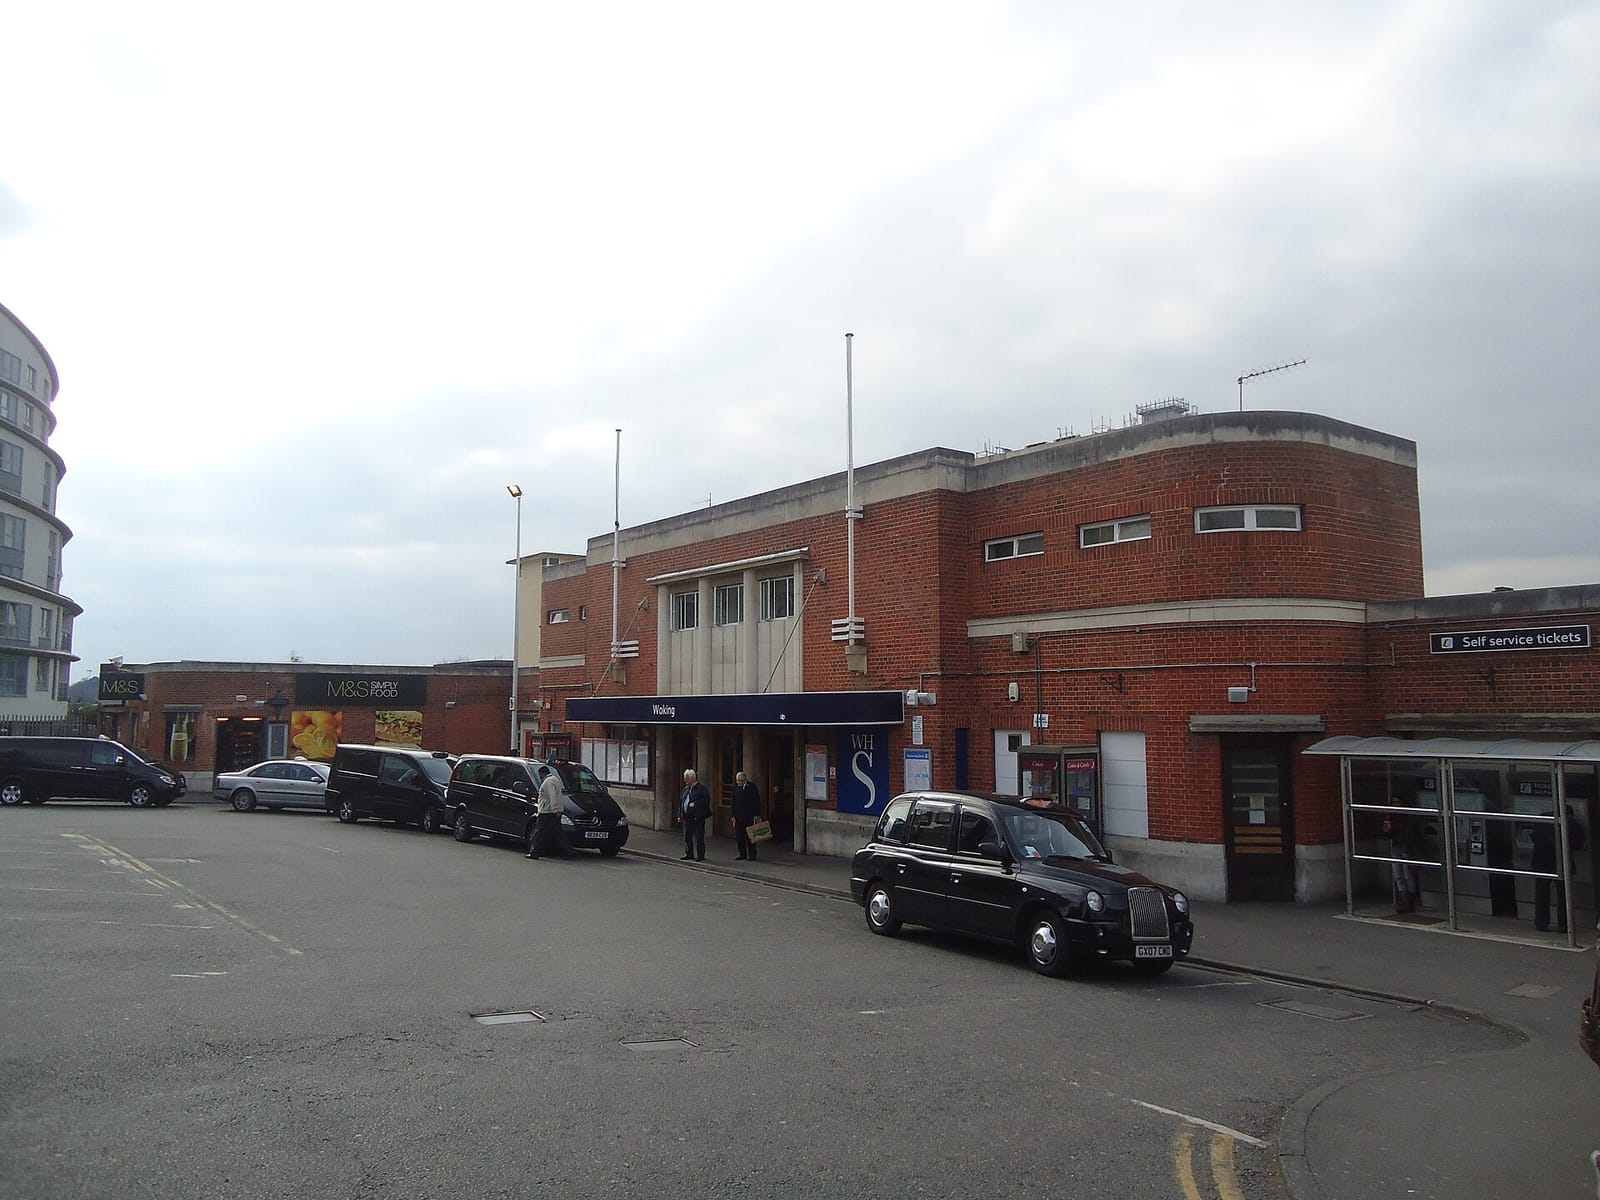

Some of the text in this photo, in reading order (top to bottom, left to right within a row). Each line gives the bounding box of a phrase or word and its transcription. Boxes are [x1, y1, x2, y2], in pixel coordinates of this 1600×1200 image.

[1462, 631, 1582, 648] Self service tickets
[102, 680, 139, 694] M&S
[327, 680, 369, 698] M&S
[370, 681, 399, 689] SIMPLY
[370, 689, 399, 698] FOOD
[652, 704, 676, 718] Woking
[851, 734, 875, 750] WH
[851, 750, 876, 809] S
